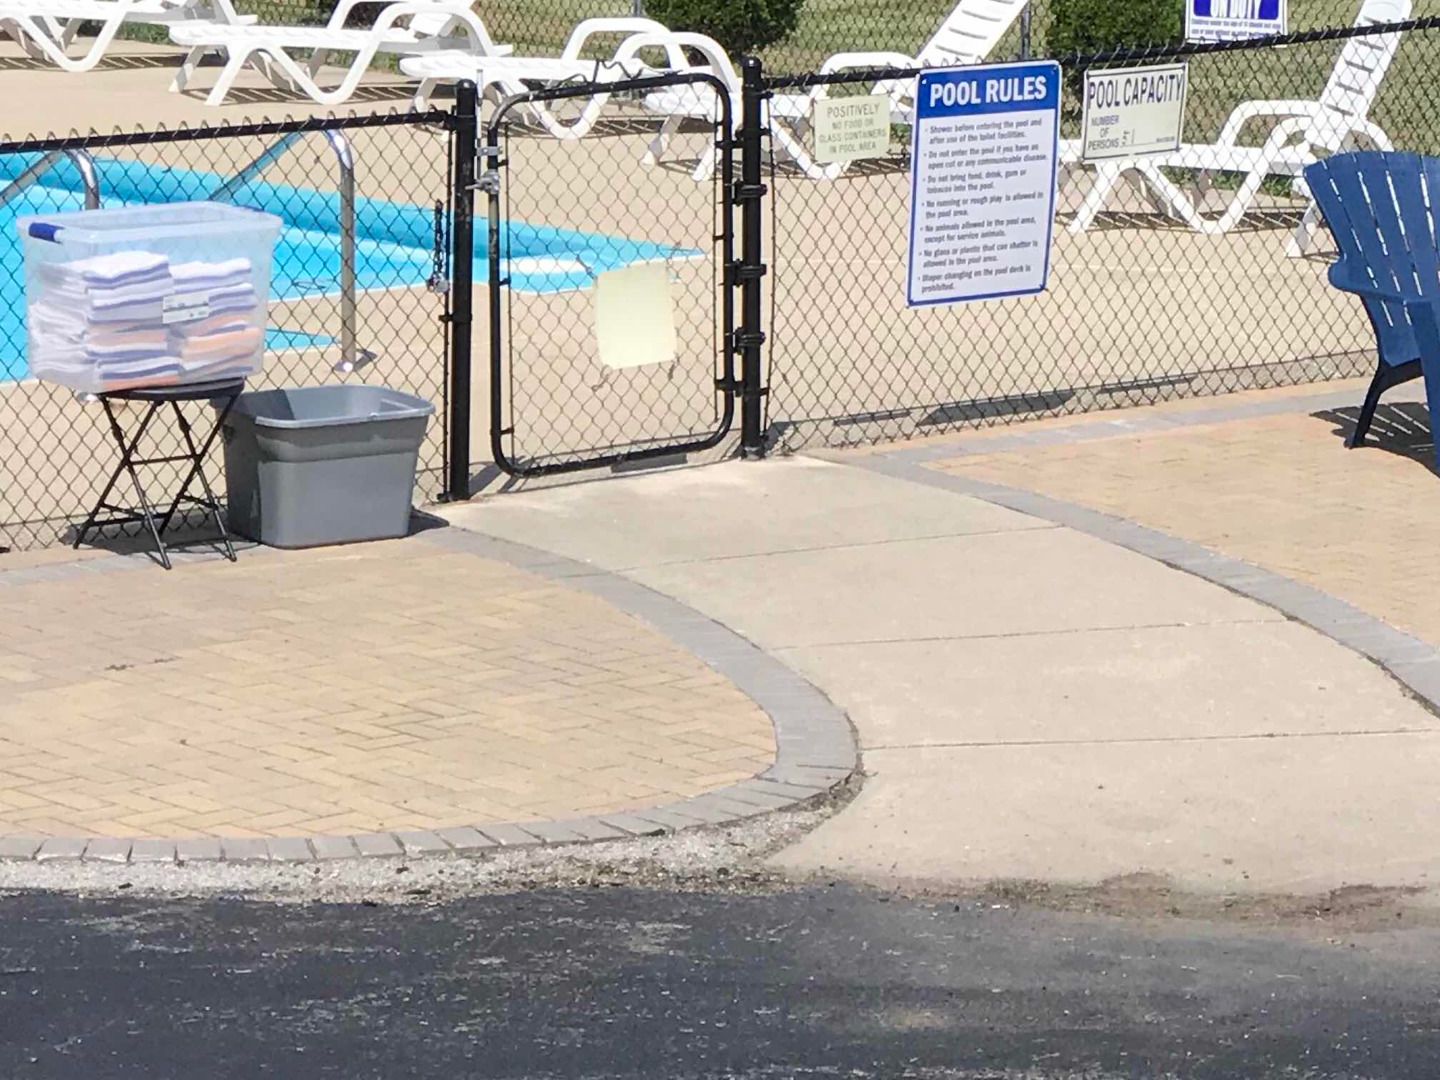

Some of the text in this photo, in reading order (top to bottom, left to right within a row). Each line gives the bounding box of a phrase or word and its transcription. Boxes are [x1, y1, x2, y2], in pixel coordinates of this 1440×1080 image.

[929, 75, 1047, 107] POOL RULES
[1088, 74, 1184, 109] POOL CAPACITY
[827, 103, 880, 118] POSITIVELY
[832, 118, 873, 129] NO FOOD OR
[930, 125, 952, 134] Shower
[955, 124, 975, 132] before
[976, 123, 1002, 131] entering
[1016, 120, 1029, 128] pool
[1091, 115, 1119, 126] NUMBER
[819, 128, 886, 143] GLASS CONTAINERS
[929, 135, 944, 144] after
[968, 133, 977, 141] the
[980, 132, 995, 140] toilet
[998, 131, 1026, 139] facilities.
[1100, 128, 1109, 137] OF
[839, 144, 856, 152] POOL
[859, 142, 876, 150] AREA
[1088, 138, 1119, 150] PERSONS
[951, 149, 967, 157] enter
[981, 147, 995, 156] pool
[928, 162, 944, 171] open
[965, 160, 976, 168] any
[977, 155, 1022, 165] communicable
[950, 173, 966, 182] bring
[968, 172, 983, 180] food,
[927, 185, 951, 194] tobacco
[968, 183, 977, 191] the
[980, 183, 994, 191] pool.
[937, 199, 960, 207] running
[970, 196, 987, 205] rough
[990, 196, 1002, 204] play
[1013, 192, 1036, 200] allowed
[926, 211, 936, 219] the
[938, 210, 951, 218] pool
[935, 223, 960, 231] animals
[962, 221, 985, 229] allowed
[1006, 218, 1019, 226] pool
[924, 235, 945, 243] except
[957, 232, 979, 240] service
[981, 230, 1006, 238] animals.
[934, 248, 950, 257] glass
[1009, 241, 1031, 249] shatter
[923, 259, 947, 268] allowed
[968, 256, 981, 265] pool
[944, 270, 972, 281] changing
[983, 268, 993, 276] the
[921, 282, 955, 293] prohibited.
